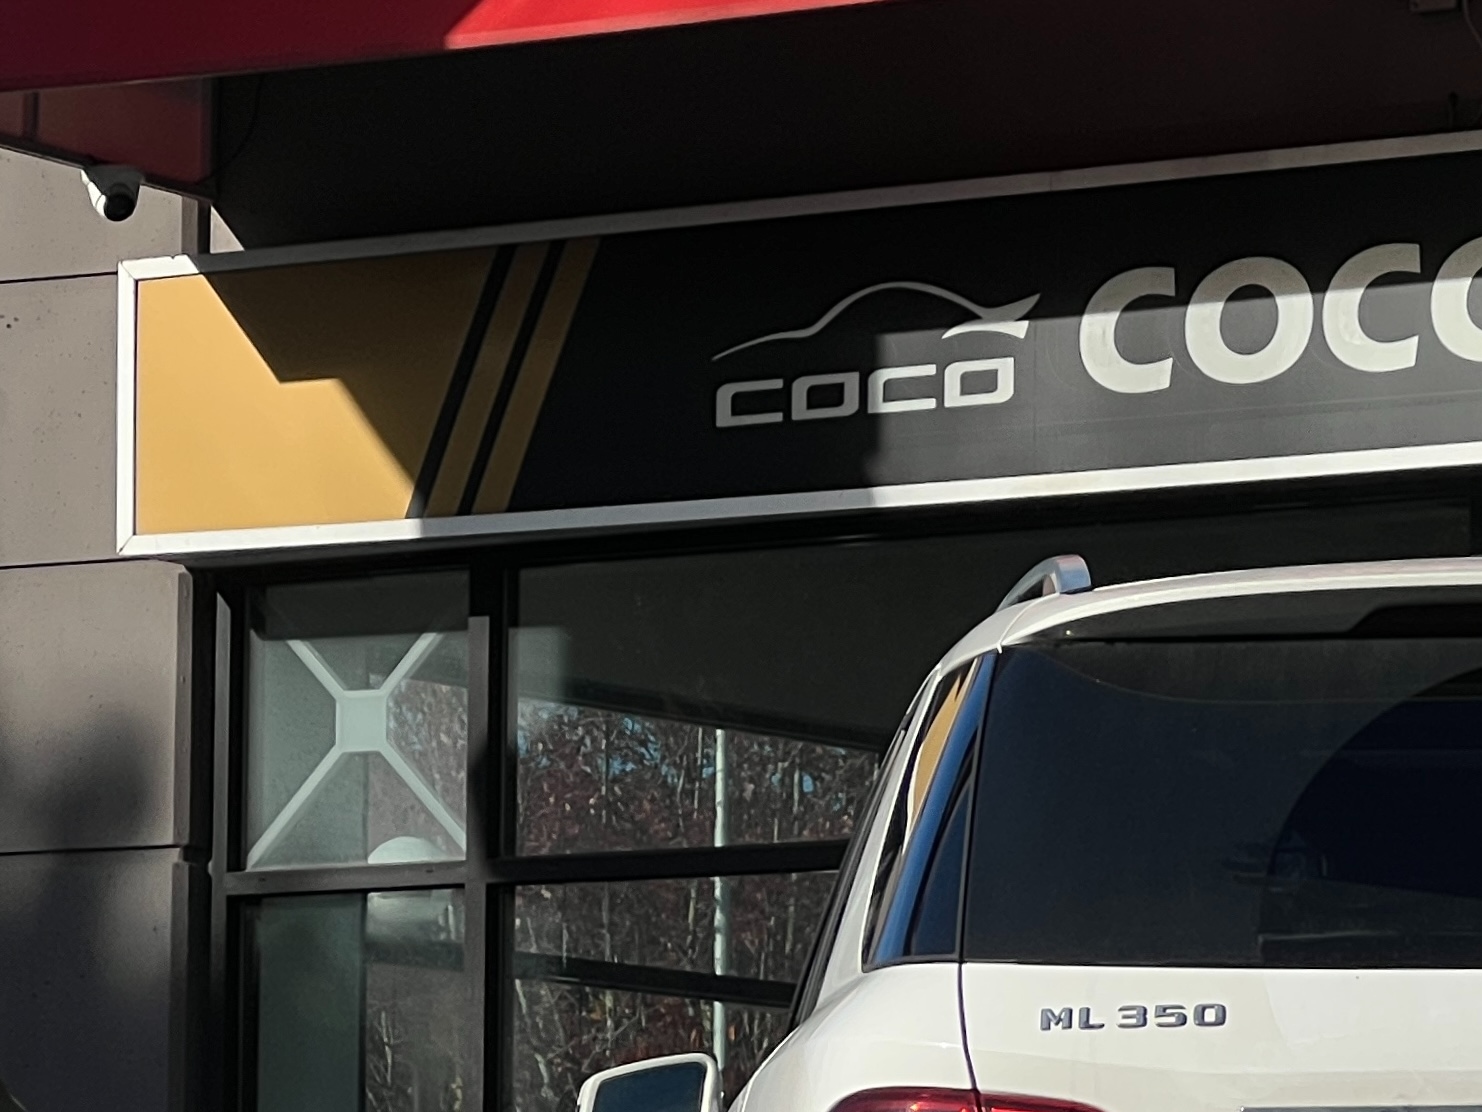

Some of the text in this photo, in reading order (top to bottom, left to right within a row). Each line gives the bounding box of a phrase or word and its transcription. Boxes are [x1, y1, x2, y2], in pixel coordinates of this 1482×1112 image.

[715, 356, 1015, 427] COCO
[1040, 1003, 1227, 1031] ML 350
